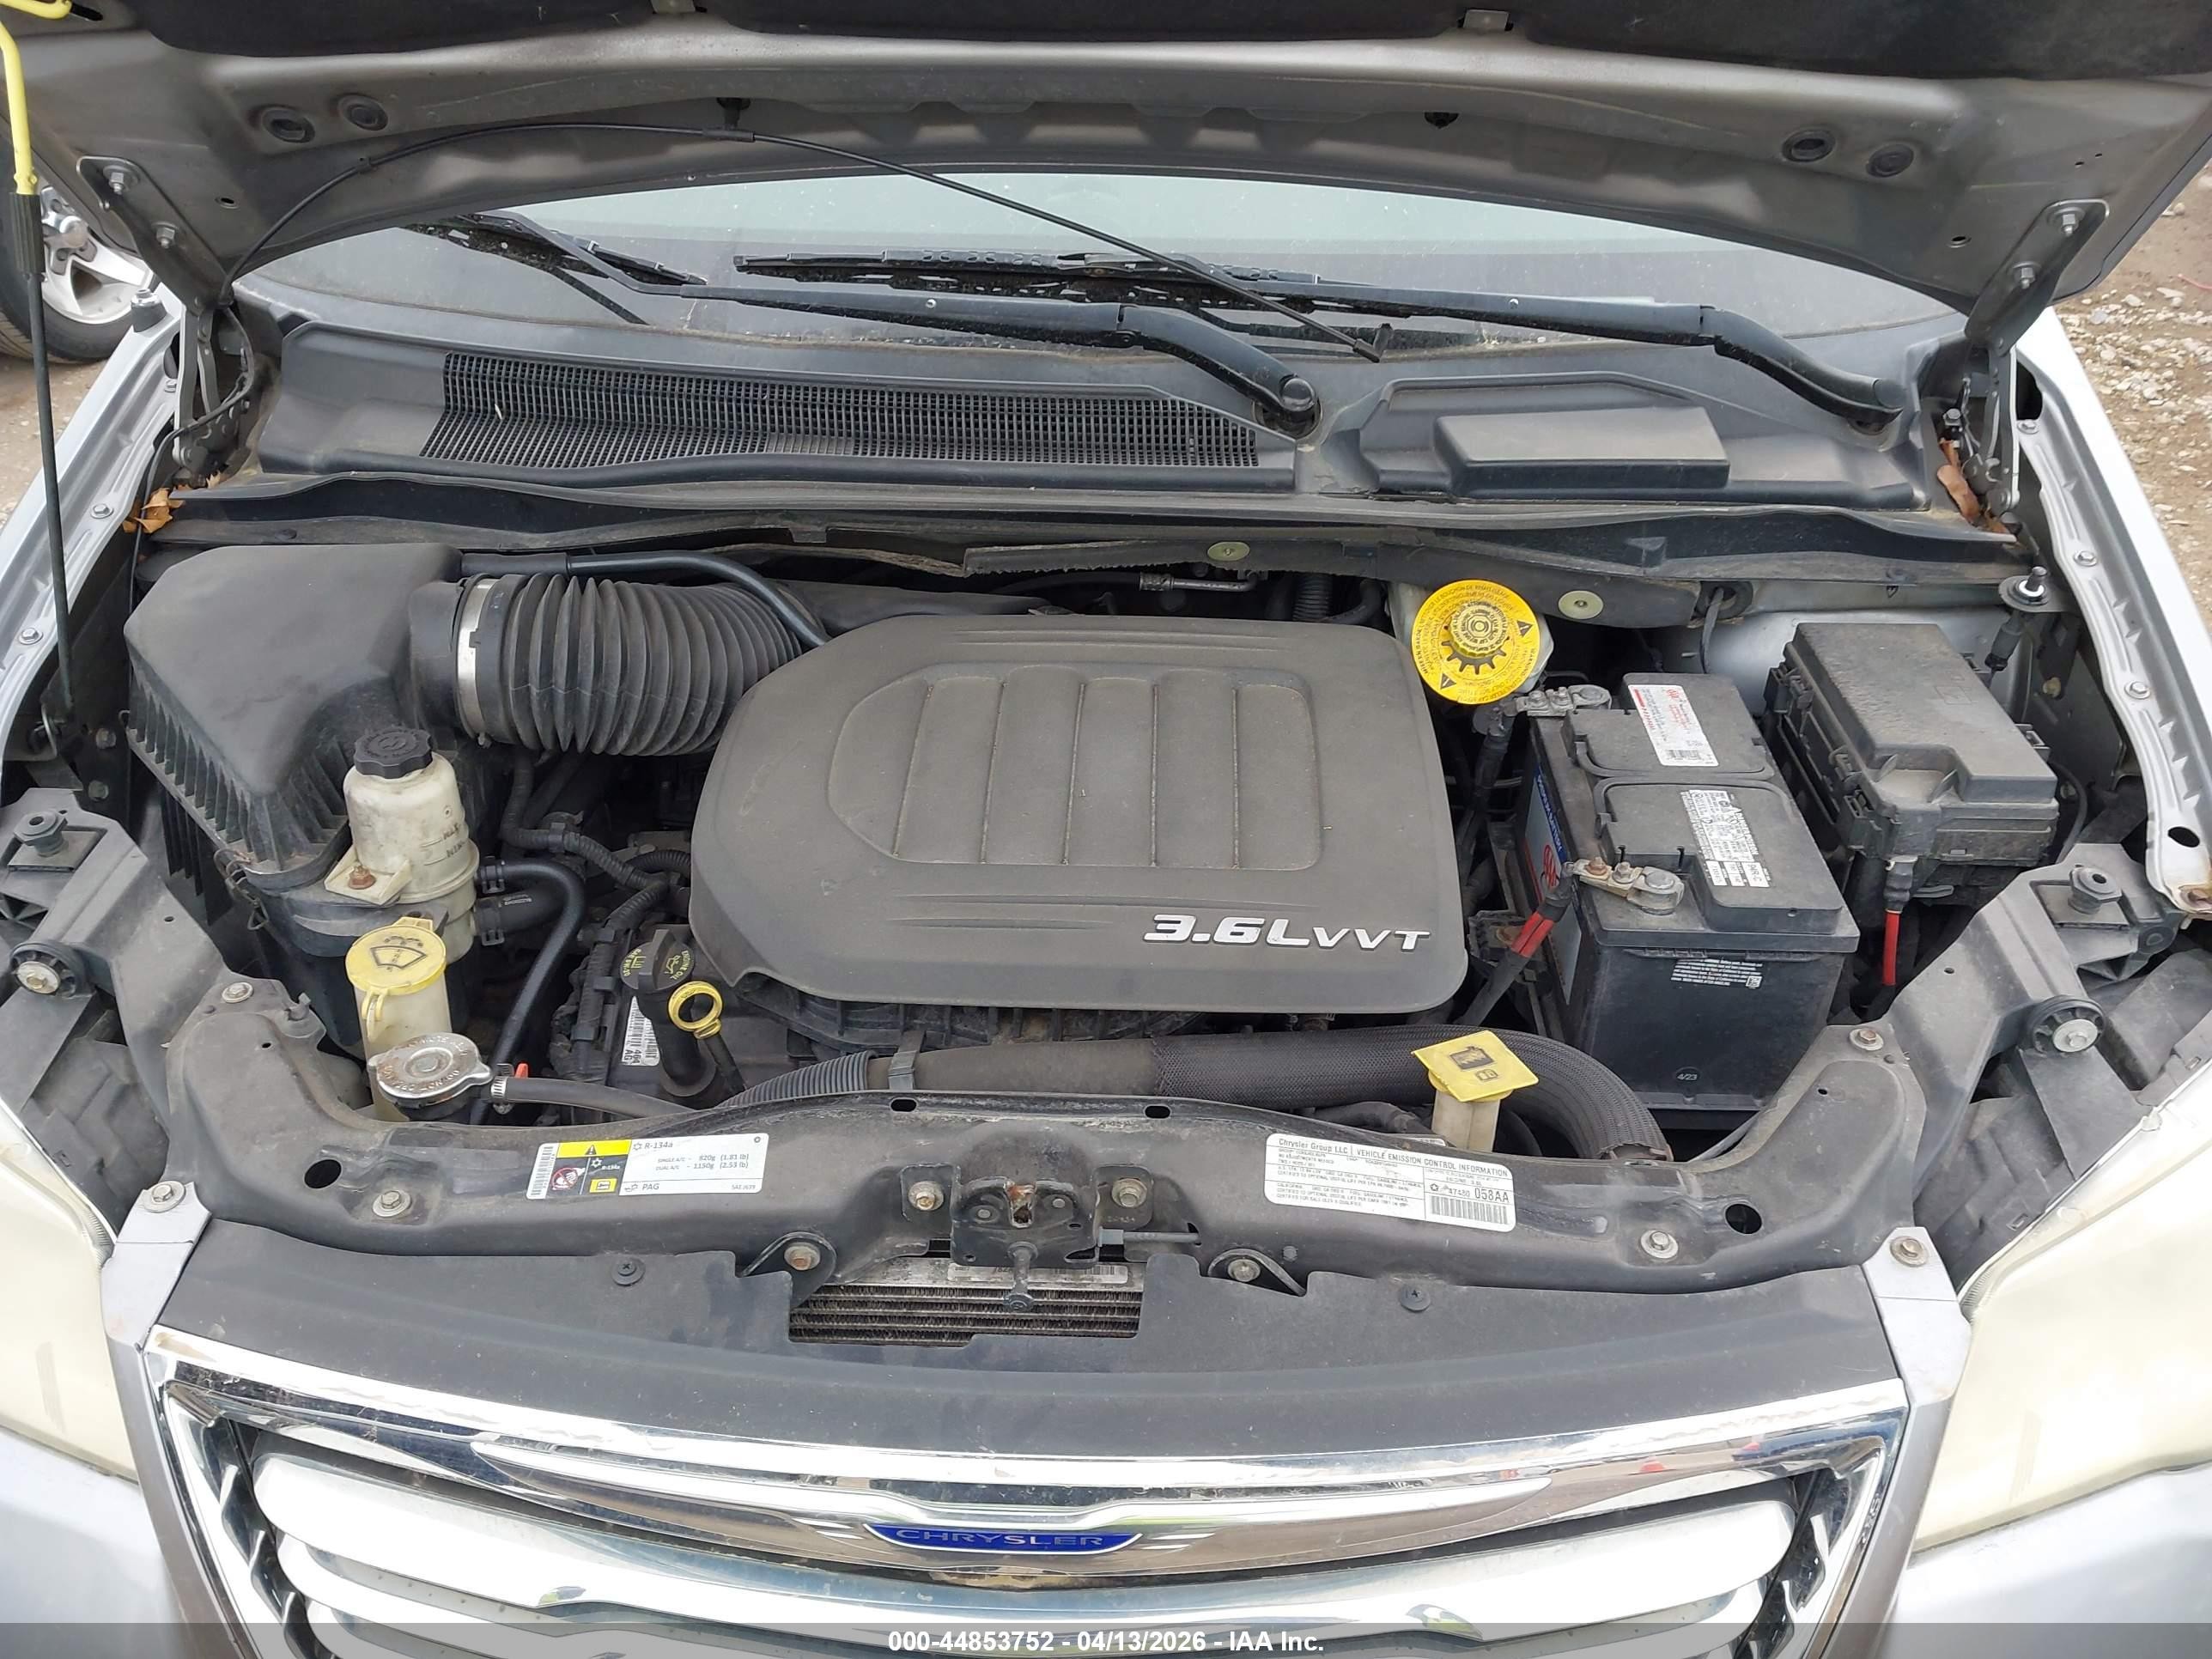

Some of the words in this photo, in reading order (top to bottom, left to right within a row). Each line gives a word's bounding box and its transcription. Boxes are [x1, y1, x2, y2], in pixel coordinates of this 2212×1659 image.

[670, 970, 684, 981] OIL
[644, 1141, 673, 1150] R-134a
[1279, 1139, 1308, 1148] Chrysler
[1310, 1142, 1332, 1152] Group
[1334, 1145, 1348, 1154] LLC
[1357, 1148, 1385, 1159] VEHICLE
[1388, 1152, 1421, 1164] EMISSION
[1424, 1158, 1456, 1170] CONTROL
[1458, 1164, 1509, 1176] INFORMATION
[1474, 1187, 1510, 1203] 058AA
[896, 1529, 1104, 1546] CHRYSLER
